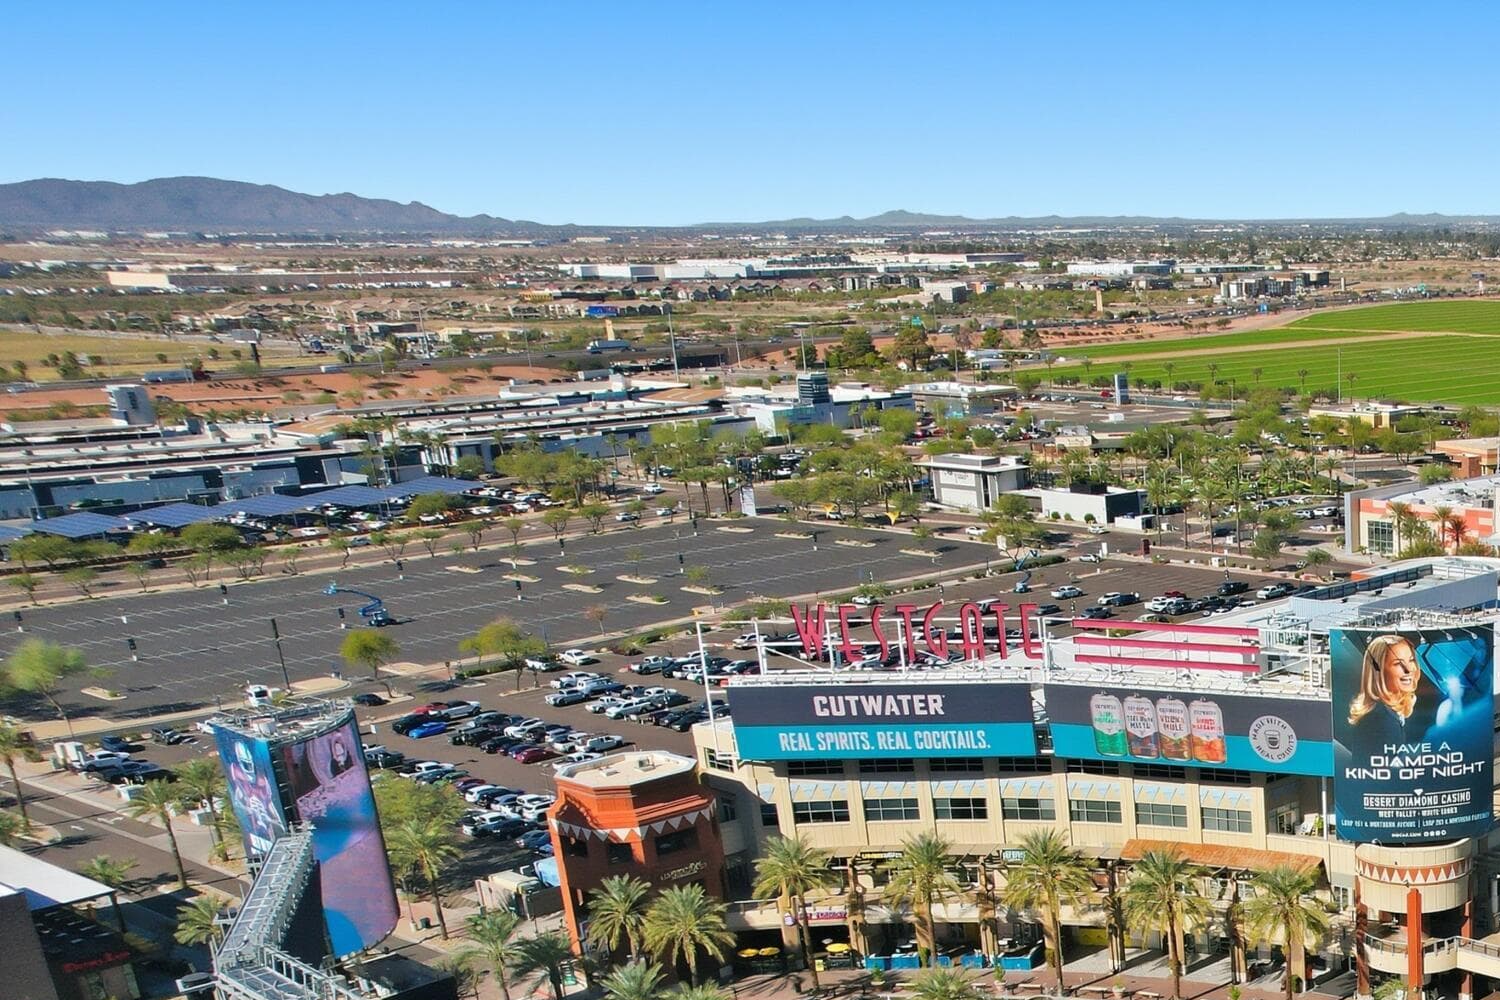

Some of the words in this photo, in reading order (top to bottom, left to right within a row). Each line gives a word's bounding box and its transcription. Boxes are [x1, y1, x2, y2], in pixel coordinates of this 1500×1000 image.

[790, 602, 1045, 663] WESTGATE
[813, 695, 945, 716] CUTWATER
[779, 733, 816, 752] REAL
[818, 732, 874, 751] SPIRITS.
[878, 732, 911, 750] REAL
[914, 730, 991, 750] COCKTAILS.
[1384, 742, 1431, 755] HAVE
[1438, 741, 1451, 751] A
[1370, 752, 1463, 768] DIAMOND
[1345, 768, 1391, 780] KIND
[1399, 768, 1425, 780] OF
[1432, 761, 1485, 778] NIGHT
[1363, 796, 1396, 807] DESERT
[1399, 795, 1438, 807] DIAMOND
[1441, 791, 1471, 803] CASINO
